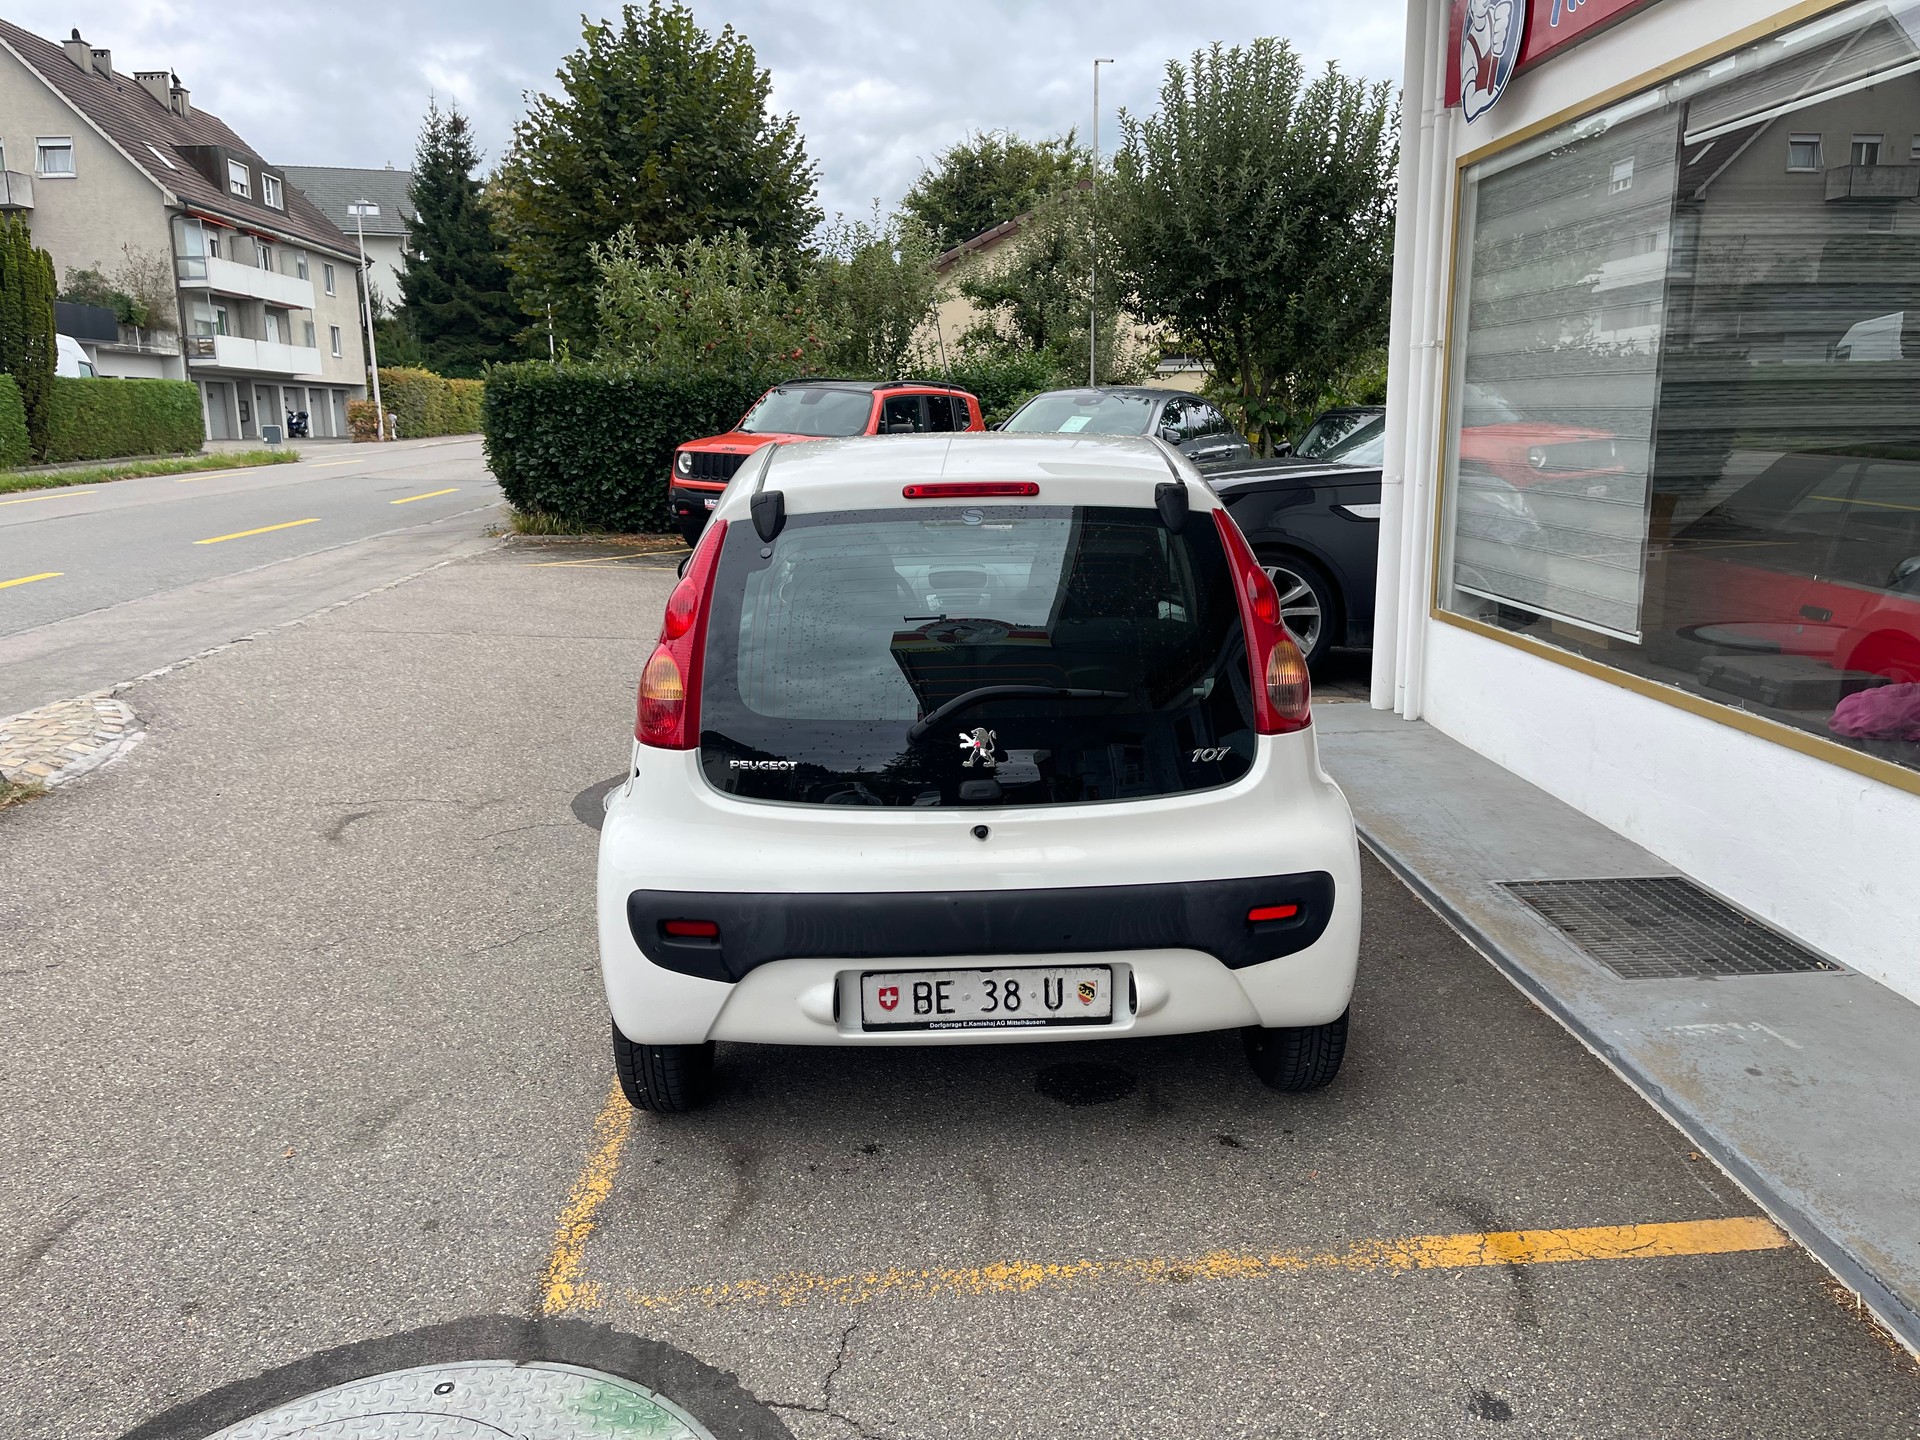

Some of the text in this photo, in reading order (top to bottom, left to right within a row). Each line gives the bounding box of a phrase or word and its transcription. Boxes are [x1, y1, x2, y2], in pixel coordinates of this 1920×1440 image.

[1192, 746, 1232, 763] 107
[729, 760, 798, 771] PEUGEOT
[913, 977, 1063, 1015] BE 38 U
